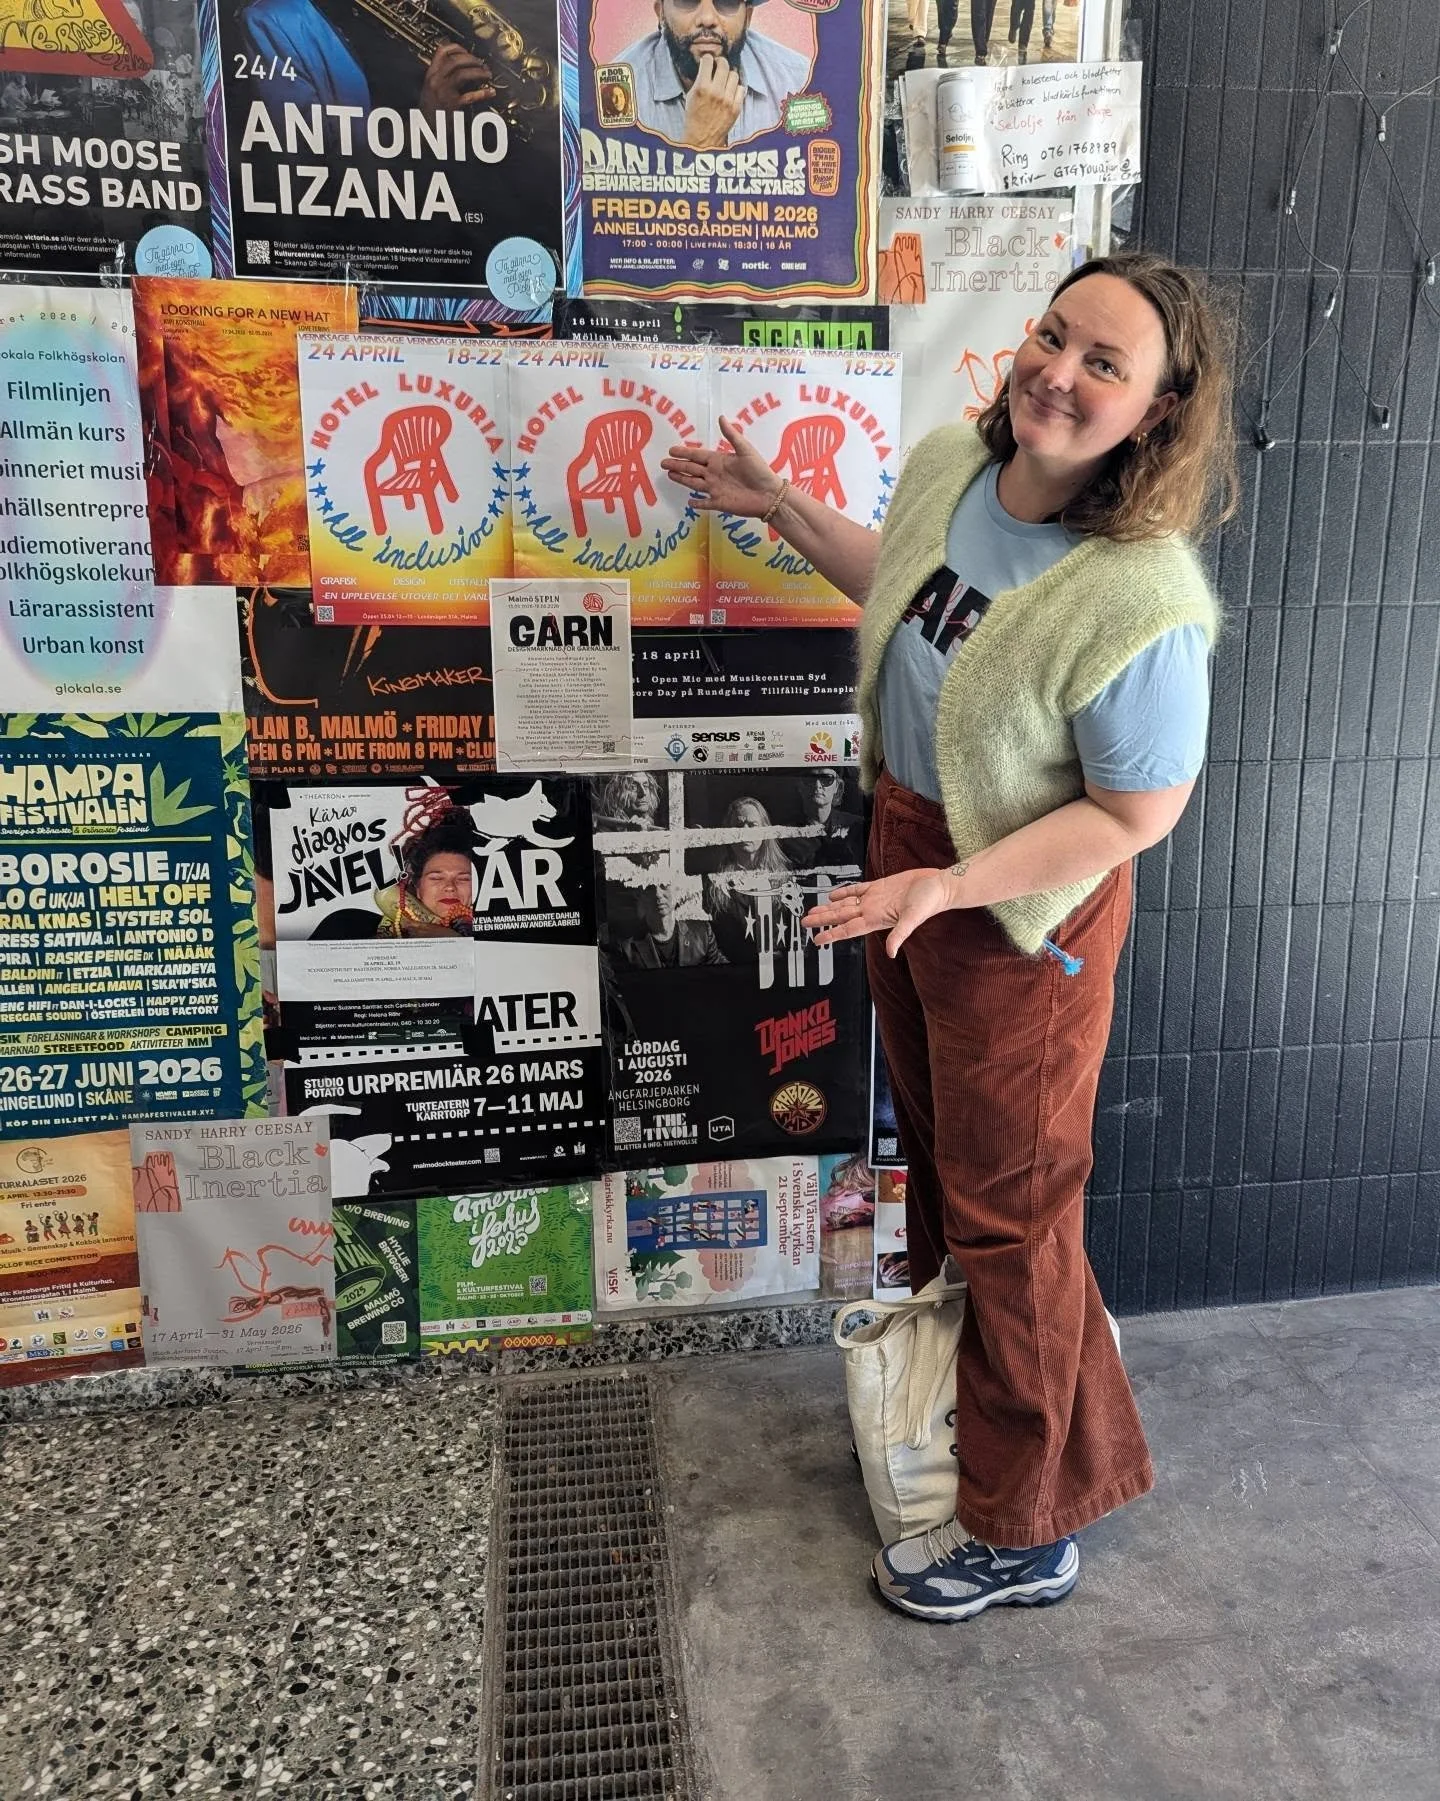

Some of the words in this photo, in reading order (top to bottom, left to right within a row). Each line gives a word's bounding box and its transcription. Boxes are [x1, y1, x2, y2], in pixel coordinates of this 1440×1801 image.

[233, 53, 297, 81] 24/4
[1056, 109, 1077, 126] från
[240, 100, 509, 164] ANTONIO
[52, 137, 182, 173] MOOSE
[580, 128, 650, 175] DAN
[672, 150, 779, 177] LOCKS
[785, 147, 806, 178] &
[1001, 144, 1029, 169] Ring
[101, 177, 203, 211] BAND
[240, 162, 462, 222] LIZANA
[464, 211, 484, 224] (ES)
[582, 174, 710, 193] BEWAREHOUSE
[715, 178, 805, 195] ALLSTARS
[592, 198, 691, 220] FREDAG
[716, 201, 769, 221] JUNI
[774, 206, 818, 223] 2026
[895, 207, 941, 219] SANDY
[949, 206, 994, 219] HARRY
[1001, 206, 1056, 219] CEESAY
[593, 221, 752, 237] ANNELUNDSGÅRDEN
[762, 223, 818, 239] MALMÖ
[622, 239, 647, 249] 17:00
[944, 226, 1049, 257] Black
[161, 303, 223, 317] LOOKING
[227, 307, 253, 318] FOR
[270, 310, 301, 321] NEW
[305, 311, 330, 323] HAT
[614, 318, 627, 327] 18
[632, 319, 661, 330] april
[299, 333, 350, 342] VERNISSAGE
[353, 335, 404, 344] VERNISSAGE
[620, 333, 659, 343] Malmö
[747, 329, 868, 350] SCANIA
[38, 350, 126, 364] Folkhögskolan
[308, 344, 336, 360] 24
[340, 346, 405, 363] APRIL
[448, 349, 503, 366] 18-22
[718, 357, 744, 373] 24
[748, 357, 807, 374] APRIL
[844, 359, 897, 377] 18-22
[7, 380, 111, 407] Filmlinjen
[310, 381, 380, 450] HOTEL
[398, 373, 504, 454] LUXURIA
[517, 386, 584, 454] HOTEL
[799, 384, 892, 463] LUXURIA
[0, 420, 73, 441] Allmän
[79, 423, 126, 441] kurs
[323, 512, 367, 552] All
[373, 516, 493, 571] inclusive
[573, 520, 690, 573] inclusive
[320, 576, 357, 586] GRAFISK
[341, 592, 398, 601] UPPLEVELSE
[9, 599, 155, 618] Lärarassistent
[509, 615, 613, 647] GARN
[22, 636, 84, 654] Urban
[90, 636, 145, 654] konst
[665, 650, 700, 662] april
[55, 682, 122, 695] glokala.se
[366, 666, 493, 697] KINGMAKER
[651, 675, 678, 685] Open
[808, 673, 827, 683] Syd
[697, 687, 750, 698] Rundgång
[295, 716, 316, 742] B,
[320, 710, 397, 740] MALMÖ
[416, 715, 482, 739] FRIDAY
[691, 731, 741, 742] sensus
[297, 742, 322, 761] PM
[335, 742, 365, 760] LIVE
[369, 742, 413, 760] FROM
[430, 742, 453, 759] PM
[804, 751, 838, 762] SKÅNE
[0, 763, 146, 804] HAMPA
[0, 797, 148, 825] FESTIVALEN
[310, 806, 357, 827] Kära
[292, 818, 387, 865] diagnos
[175, 862, 210, 882] IT/JA
[99, 885, 159, 907] HELT
[163, 883, 211, 906] OFF
[39, 911, 92, 929] KNAS
[106, 909, 173, 927] SYSTER
[178, 908, 212, 924] SOL
[43, 931, 105, 947] SATIVA
[124, 928, 197, 944] ANTONIO
[45, 950, 93, 965] RASKE
[95, 948, 143, 962] PENGE
[73, 965, 112, 979] ETZIA
[123, 962, 216, 977] MARKANDEYA
[44, 980, 106, 994] ANGELICA
[107, 979, 143, 993] MAVA
[90, 1007, 145, 1019] ÖSTERLEN
[172, 1005, 219, 1016] FACTORY
[166, 1025, 222, 1036] CAMPING
[754, 998, 831, 1056] DANKO
[43, 1042, 125, 1053] STREETFOOD
[624, 1039, 680, 1056] LÖRDAG
[768, 1018, 837, 1076] JONES
[628, 1053, 688, 1070] AUGUSTI
[75, 1061, 134, 1088] JUNI
[138, 1056, 223, 1085] 2026
[347, 1064, 482, 1095] URPREMIÄR
[486, 1064, 515, 1085] 26
[519, 1059, 584, 1083] MARS
[634, 1069, 672, 1084] 2026
[85, 1088, 134, 1106] SKÅNE
[406, 1098, 470, 1113] TURTEATERN
[539, 1089, 584, 1112] MAJ
[618, 1096, 691, 1112] HELSINGBORG
[772, 1084, 822, 1112] BABOON
[416, 1107, 470, 1122] KÄRRTORP
[145, 1128, 192, 1141] SANDY
[200, 1126, 247, 1139] HARRY
[254, 1121, 313, 1136] CEESAY
[643, 1124, 698, 1141] TIVOLI
[197, 1140, 310, 1171] Black
[413, 1158, 482, 1170] malmodockteater.com
[62, 1174, 87, 1183] 2026
[185, 1169, 328, 1201] Inertia
[792, 1168, 804, 1219] Svenska
[363, 1209, 410, 1229] BREWING
[777, 1191, 788, 1257] september
[805, 1193, 817, 1255] Vänstern
[387, 1236, 412, 1267] HYLLIE
[486, 1227, 529, 1258] 2025
[790, 1222, 804, 1267] kyrkan
[44, 1252, 98, 1264] COMPETITION
[378, 1240, 410, 1284] BRYGGERI
[462, 1283, 524, 1293] KULTURFESTIVAL
[606, 1268, 618, 1295] ViSK
[342, 1285, 368, 1304] 2025
[167, 1330, 203, 1343] April
[240, 1328, 267, 1340] May
[272, 1323, 302, 1336] 2026
